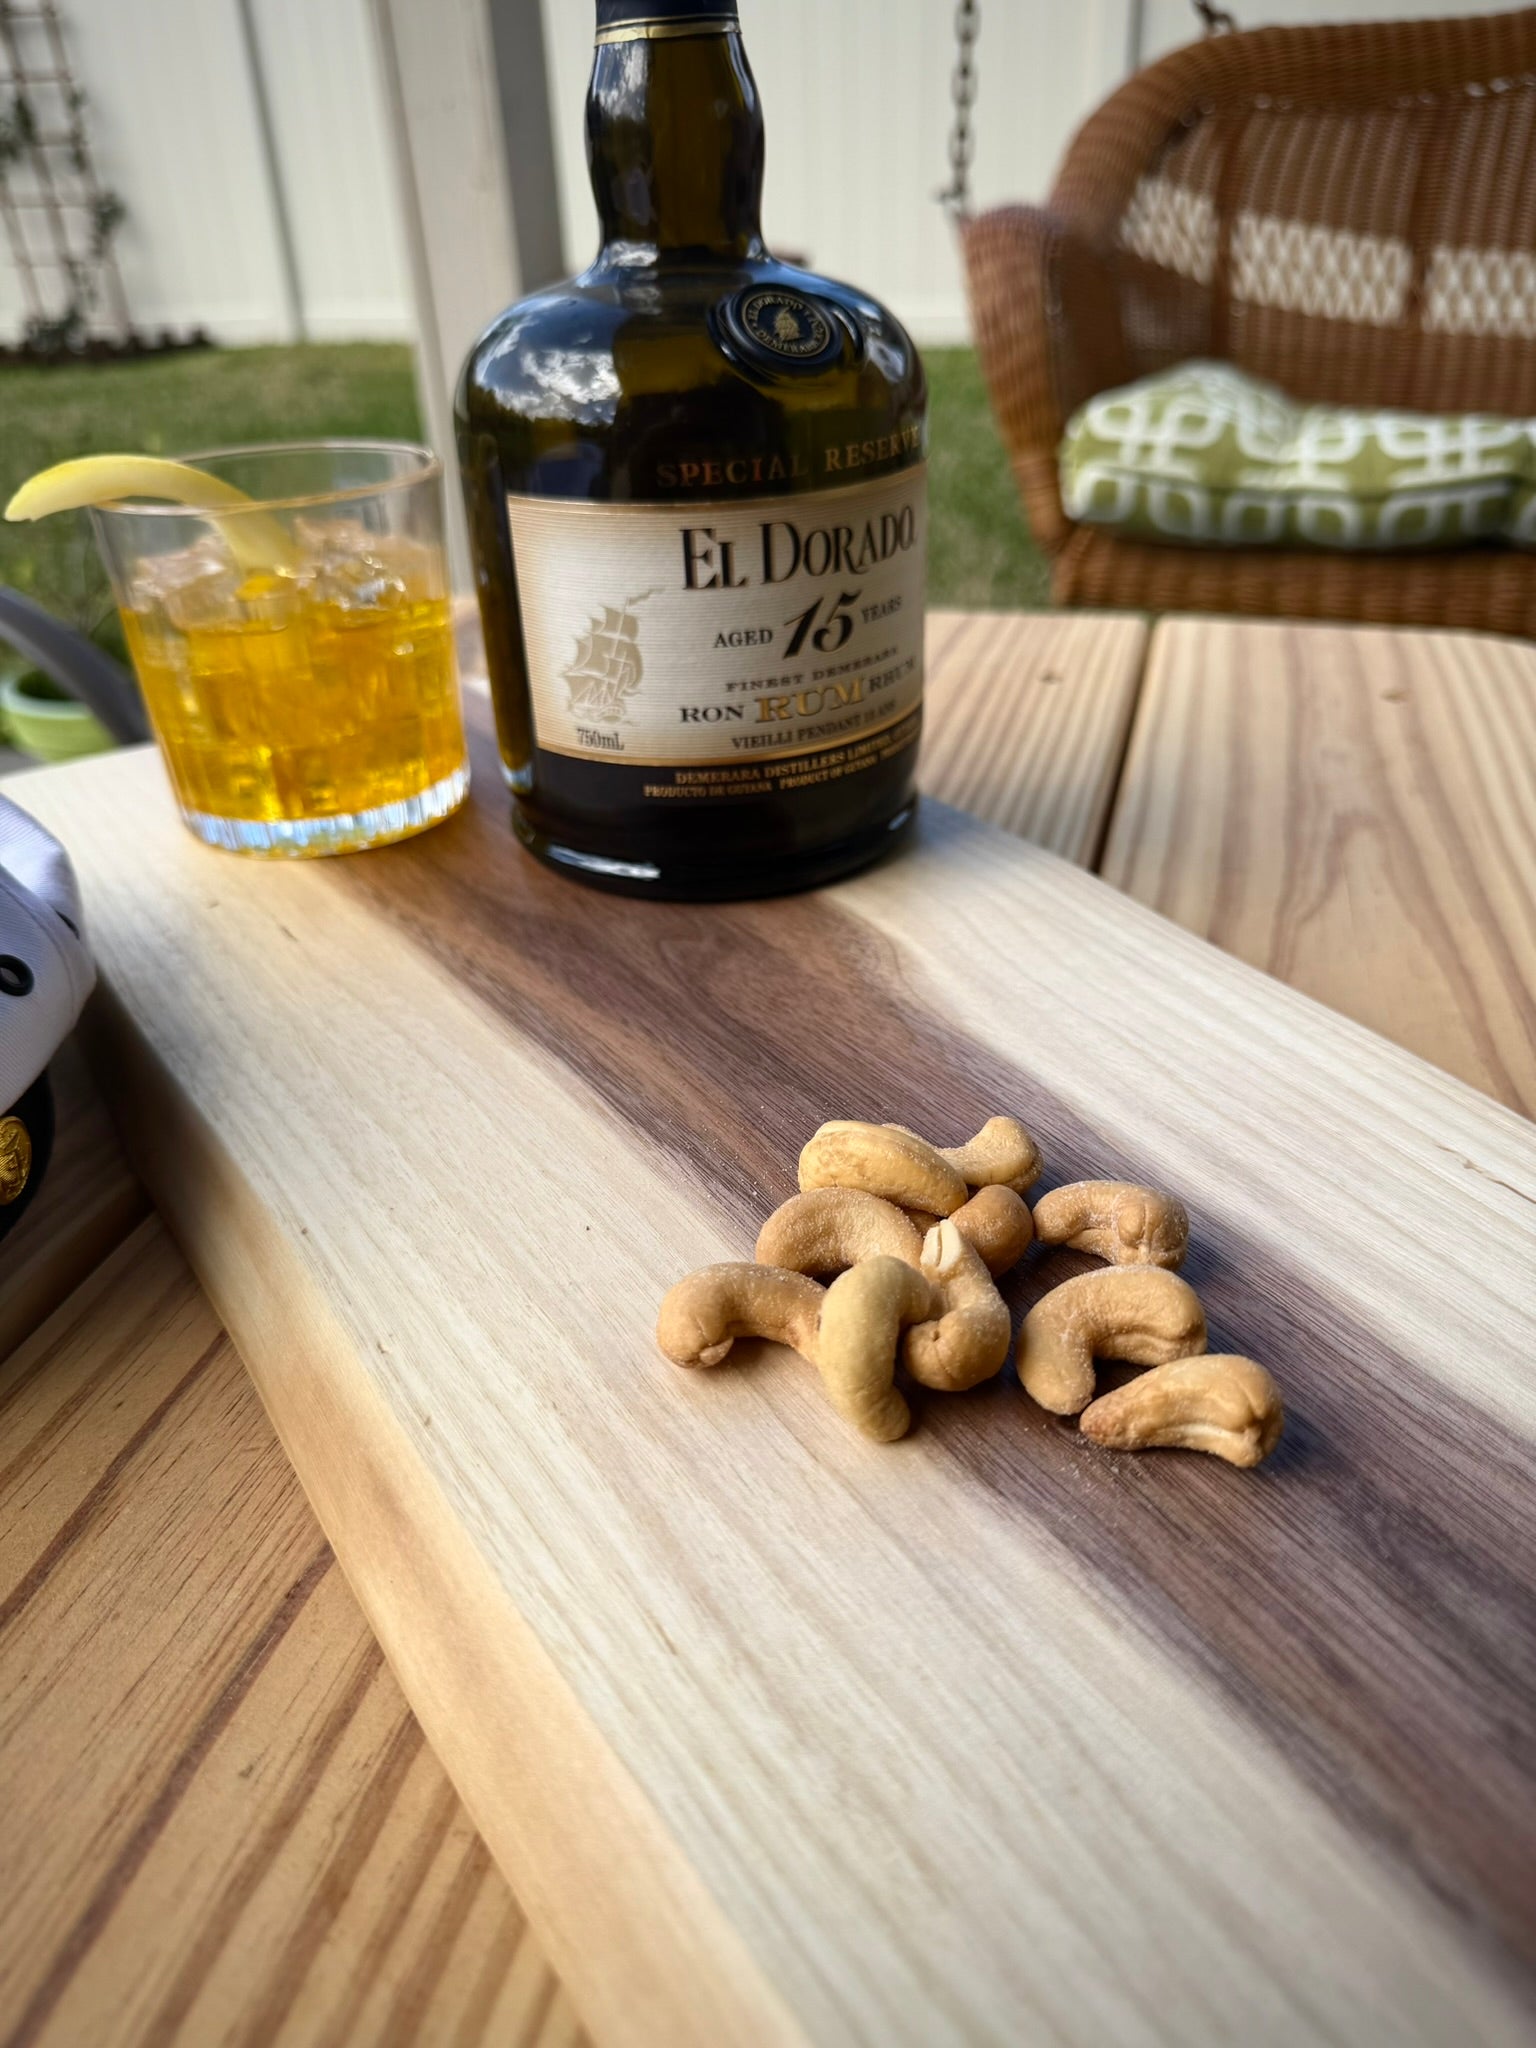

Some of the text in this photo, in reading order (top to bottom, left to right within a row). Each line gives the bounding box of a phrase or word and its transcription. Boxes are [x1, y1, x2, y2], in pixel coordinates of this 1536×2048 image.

[656, 426, 921, 488] SPECIAL RESERVE
[680, 504, 917, 590] EL DORADO
[713, 589, 902, 660] AGED 15 YEARS
[679, 657, 916, 724] RON RUM RHUM
[725, 646, 899, 693] FINEST DEMERARA
[576, 726, 625, 751] 750mL
[731, 731, 793, 750] VIEILLI
[797, 714, 862, 742] PENDANT
[643, 785, 707, 798] PRODUCTO
[778, 772, 829, 791] PRODUCT
[675, 768, 761, 785] DEMERARA
[764, 749, 847, 779] DISTILLERS
